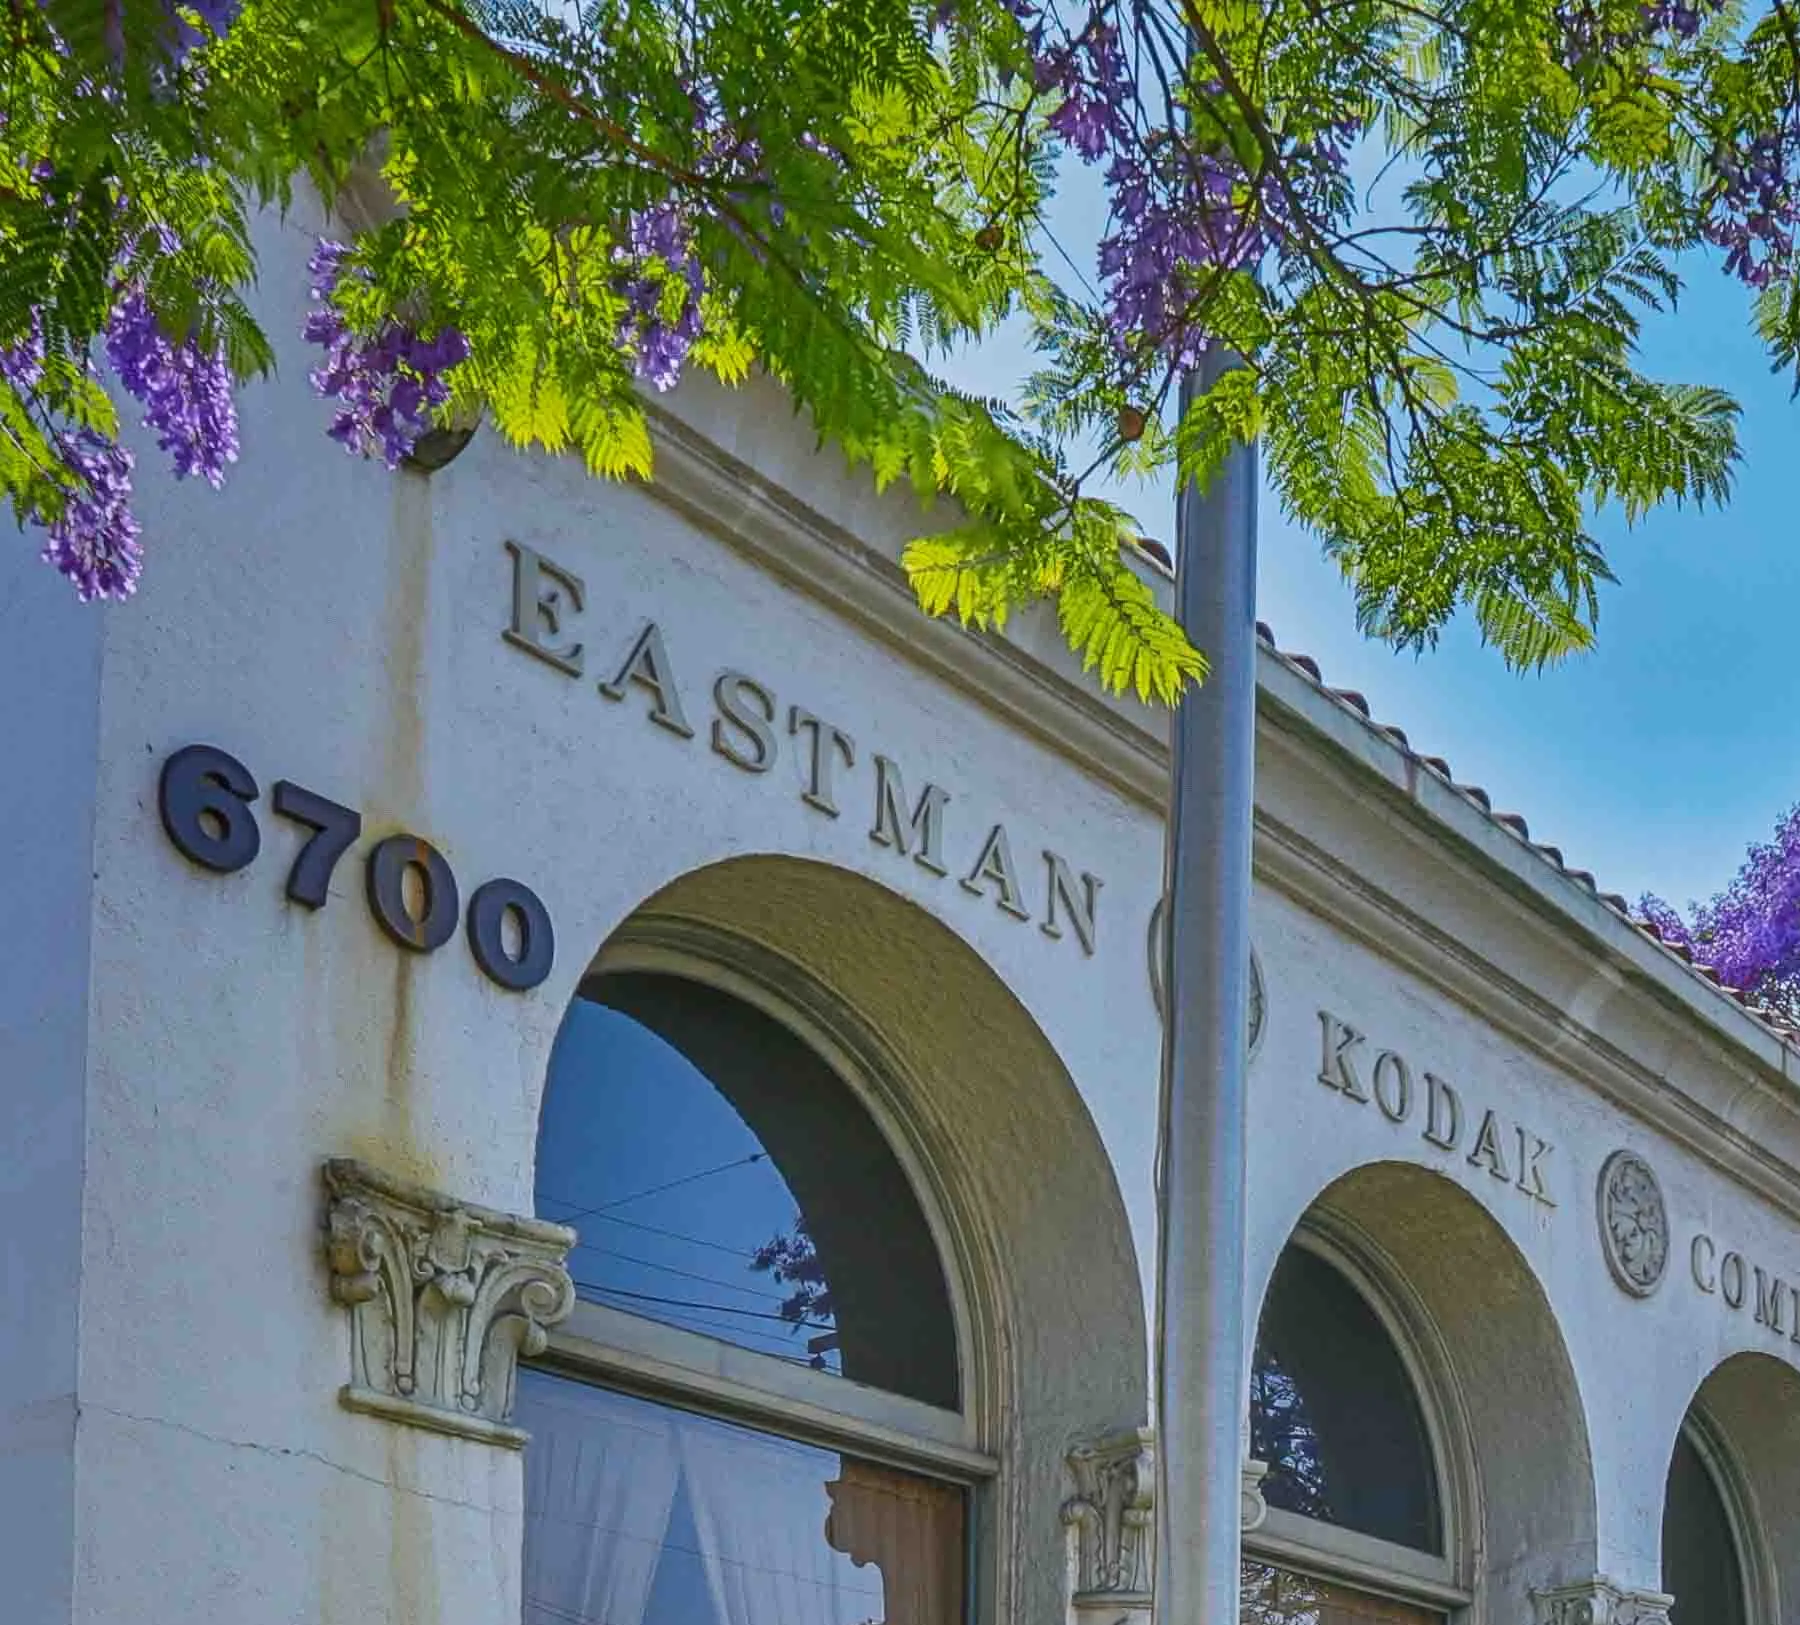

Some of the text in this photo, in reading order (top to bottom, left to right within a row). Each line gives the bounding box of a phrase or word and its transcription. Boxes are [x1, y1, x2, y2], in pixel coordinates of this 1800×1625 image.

[158, 743, 554, 991] 6700
[502, 539, 1103, 955] EASTMAN
[1317, 1010, 1558, 1207] KODAK
